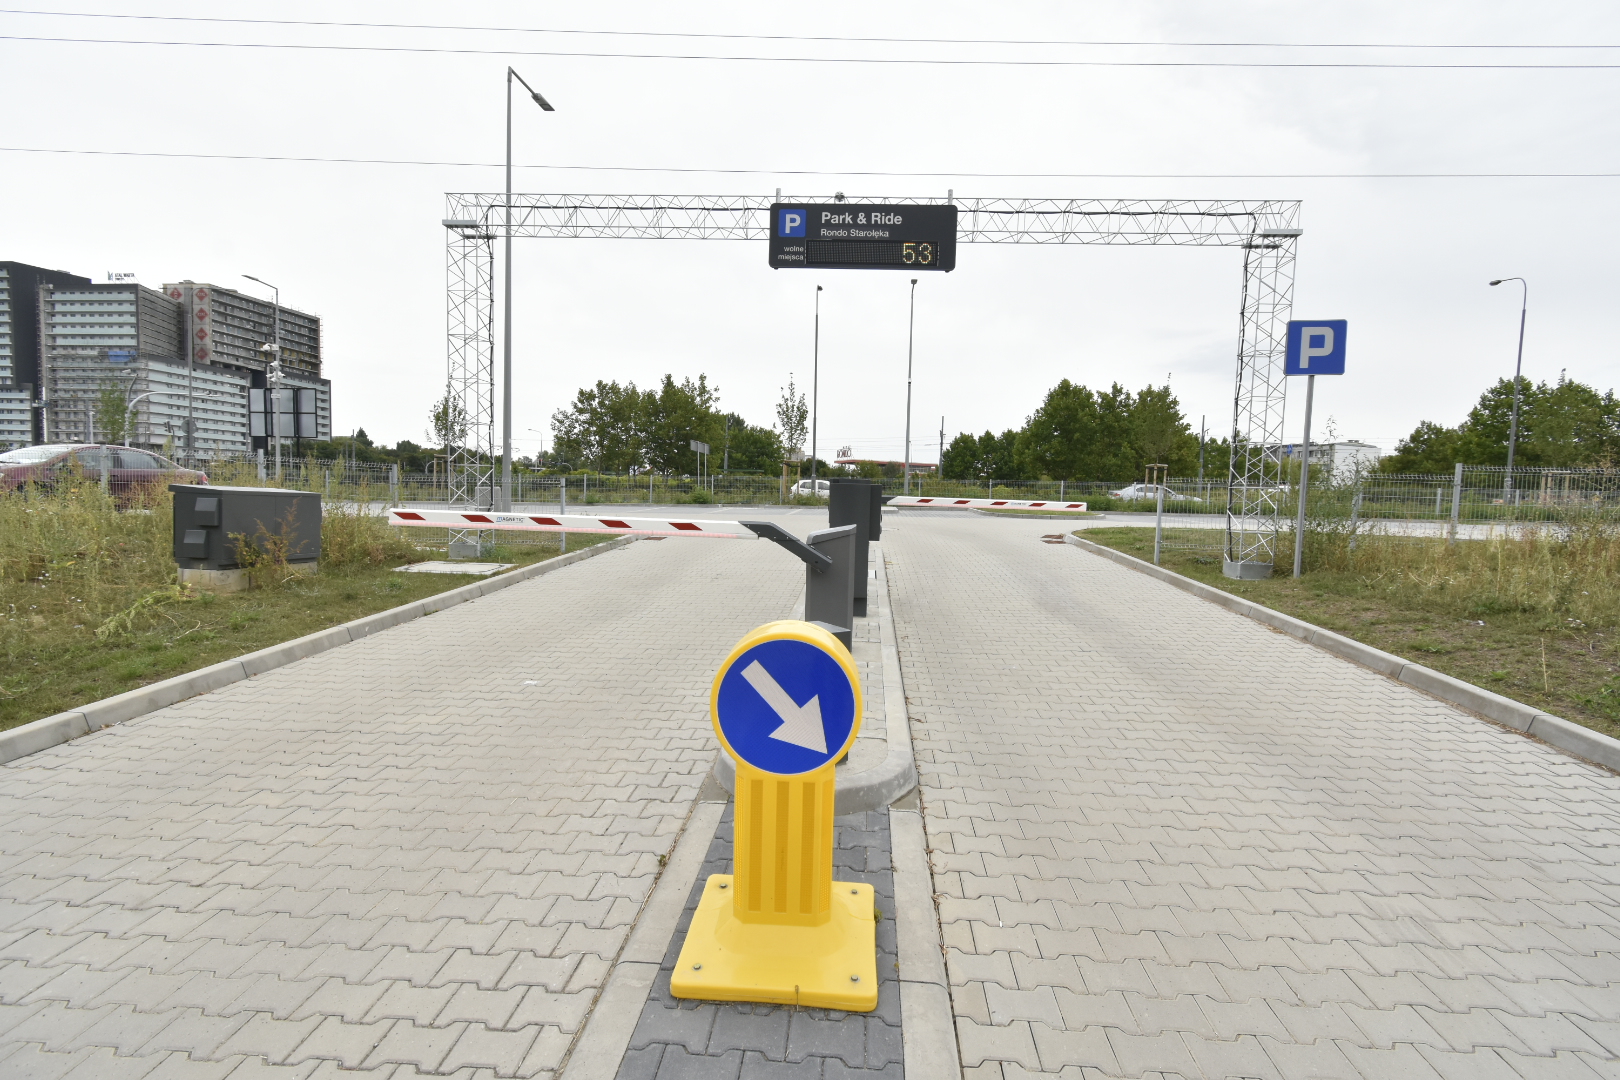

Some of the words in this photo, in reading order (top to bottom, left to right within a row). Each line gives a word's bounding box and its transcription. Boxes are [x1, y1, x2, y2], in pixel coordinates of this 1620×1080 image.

[785, 214, 800, 233] P
[821, 212, 853, 224] Park
[857, 212, 867, 224] &
[871, 212, 902, 224] Ride
[821, 228, 847, 237] Rondo
[903, 243, 932, 264] 53
[1299, 326, 1334, 368] P
